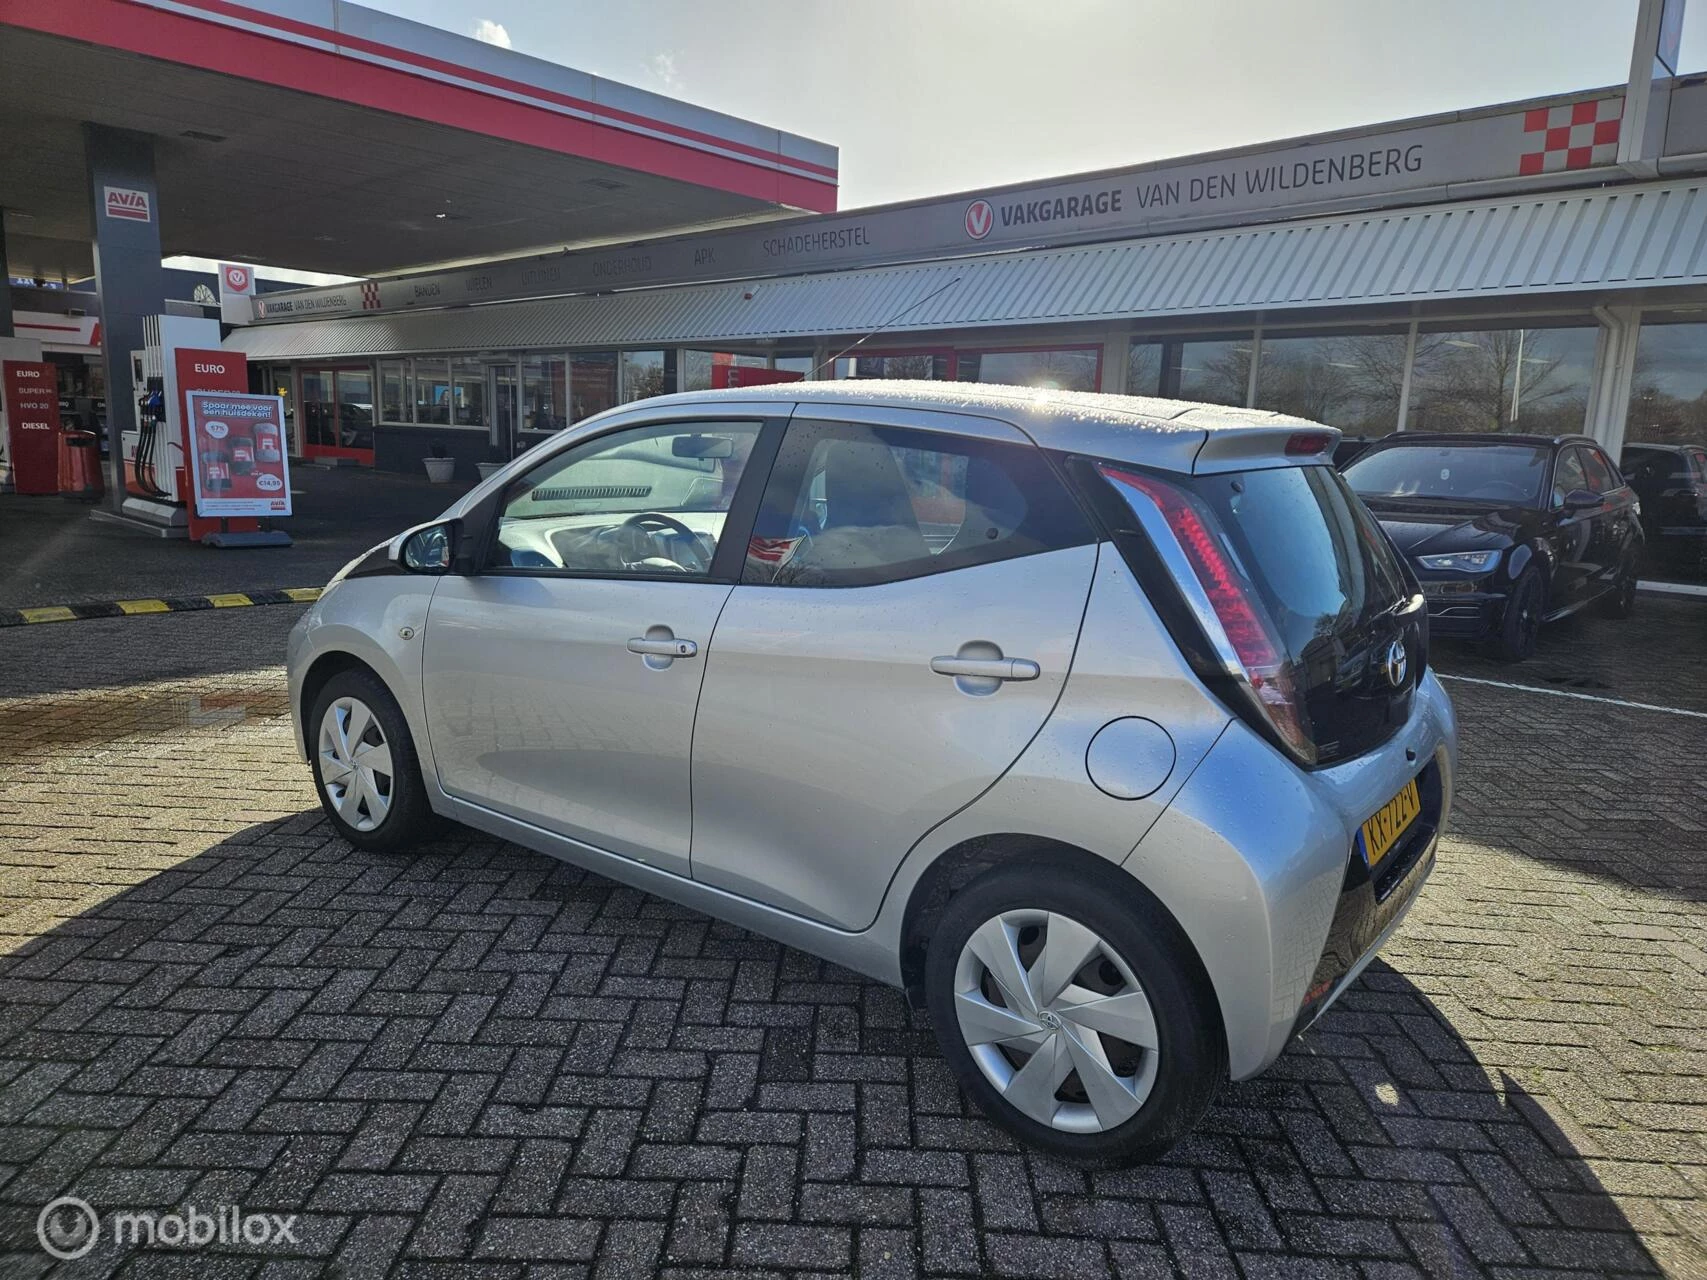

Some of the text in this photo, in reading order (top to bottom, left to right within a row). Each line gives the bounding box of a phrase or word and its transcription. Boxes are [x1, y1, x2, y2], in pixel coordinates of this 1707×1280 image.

[1001, 190, 1122, 227] VAKGARAGE
[1136, 183, 1183, 210] VAN
[1188, 172, 1237, 202] DEN
[1245, 145, 1423, 194] WILDENBERG
[108, 192, 147, 209] AVIA
[763, 226, 871, 257] SCHADEHERSTEL
[694, 248, 717, 266] APK
[592, 256, 652, 278] ONDERHOUD
[414, 283, 441, 298] BANDEN
[465, 276, 493, 292] WIELEN
[16, 370, 40, 378] EURO
[194, 363, 225, 374] EURO
[203, 401, 230, 410] Spaar
[22, 422, 50, 430] DIESEL
